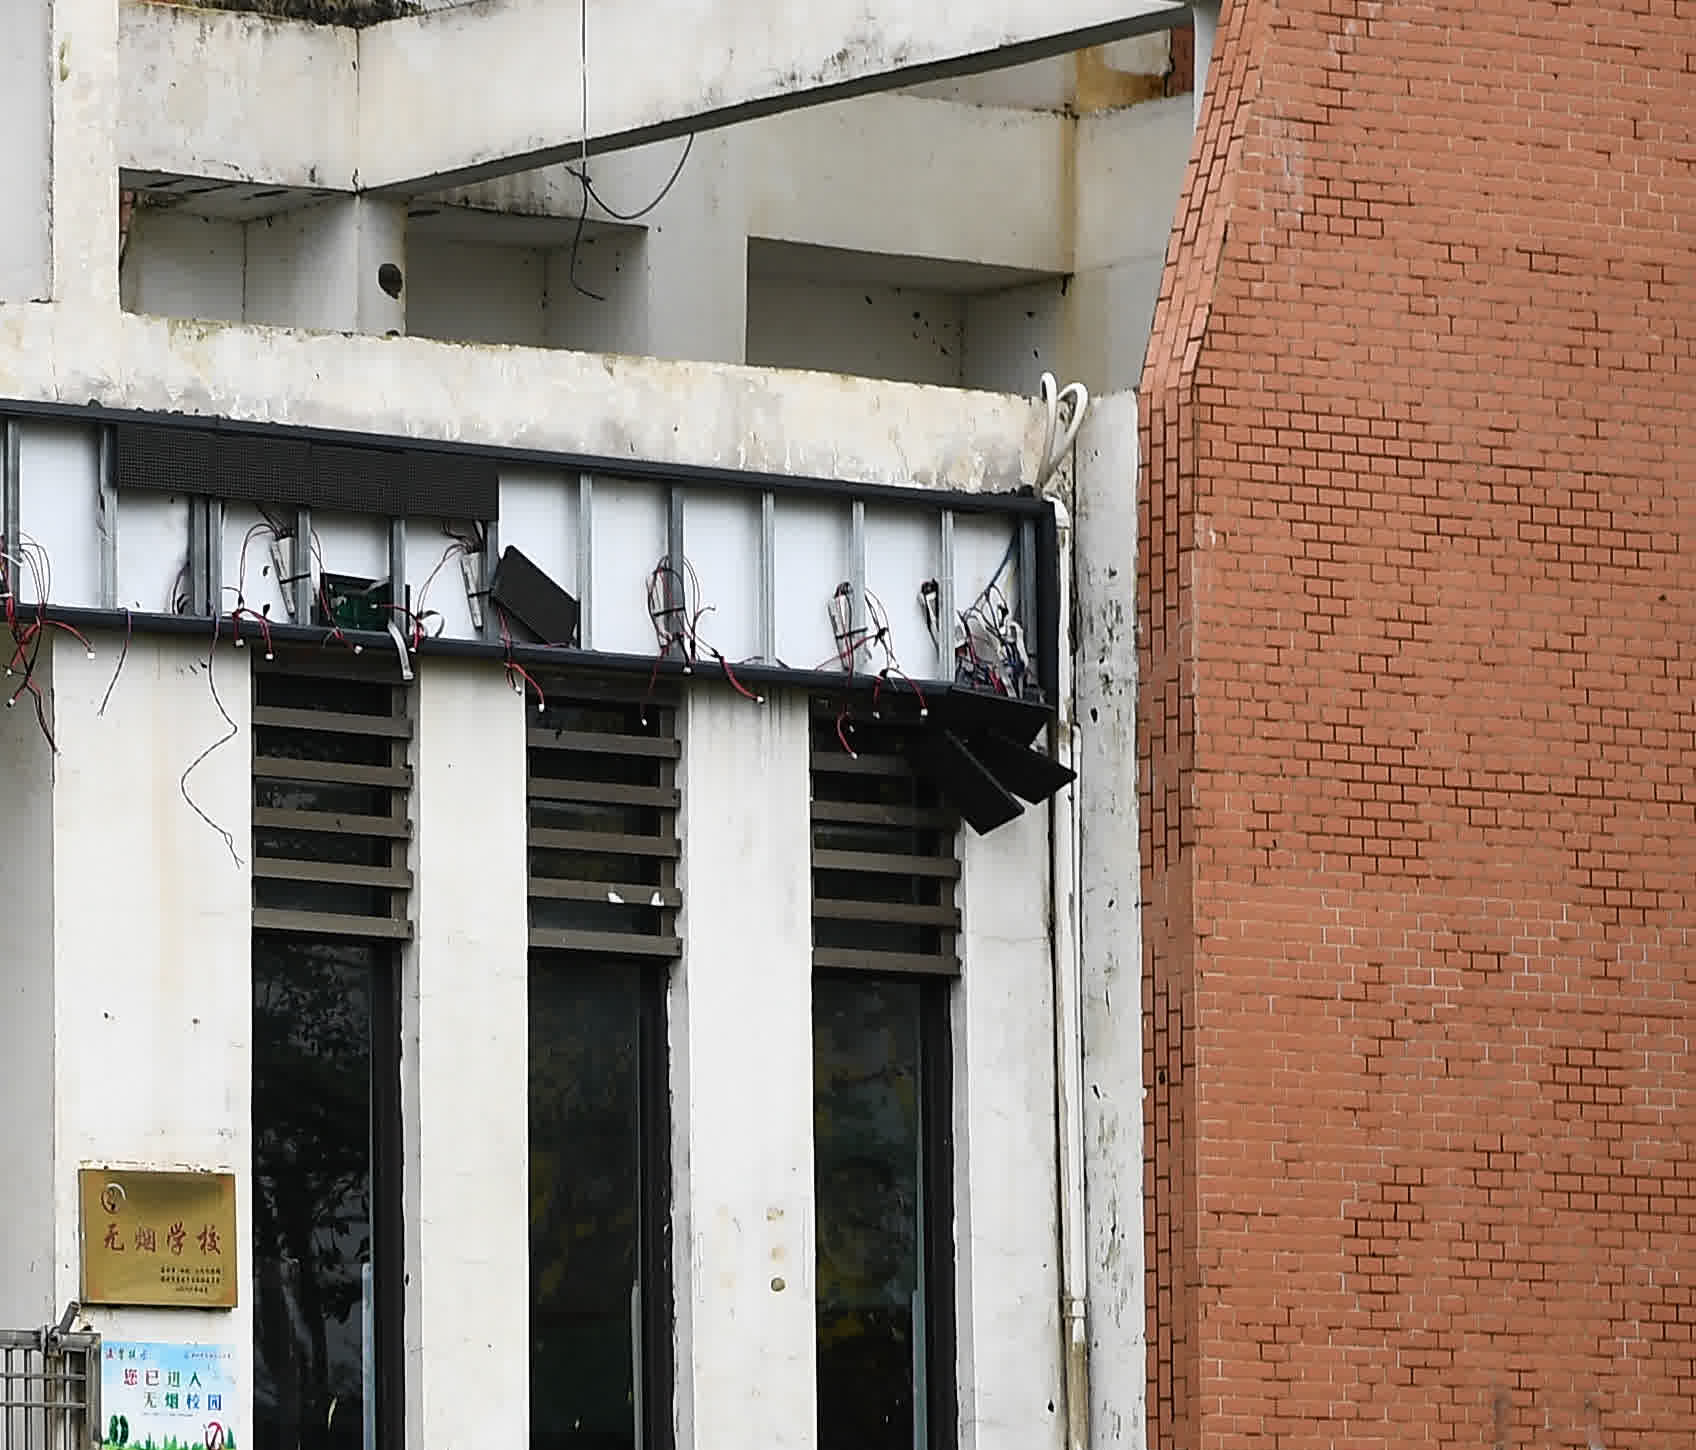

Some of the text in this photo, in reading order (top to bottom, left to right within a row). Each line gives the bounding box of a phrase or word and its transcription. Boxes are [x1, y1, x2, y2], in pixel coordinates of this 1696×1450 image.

[123, 1368, 201, 1388] 您已进入
[144, 1391, 222, 1411] 无烟校园
